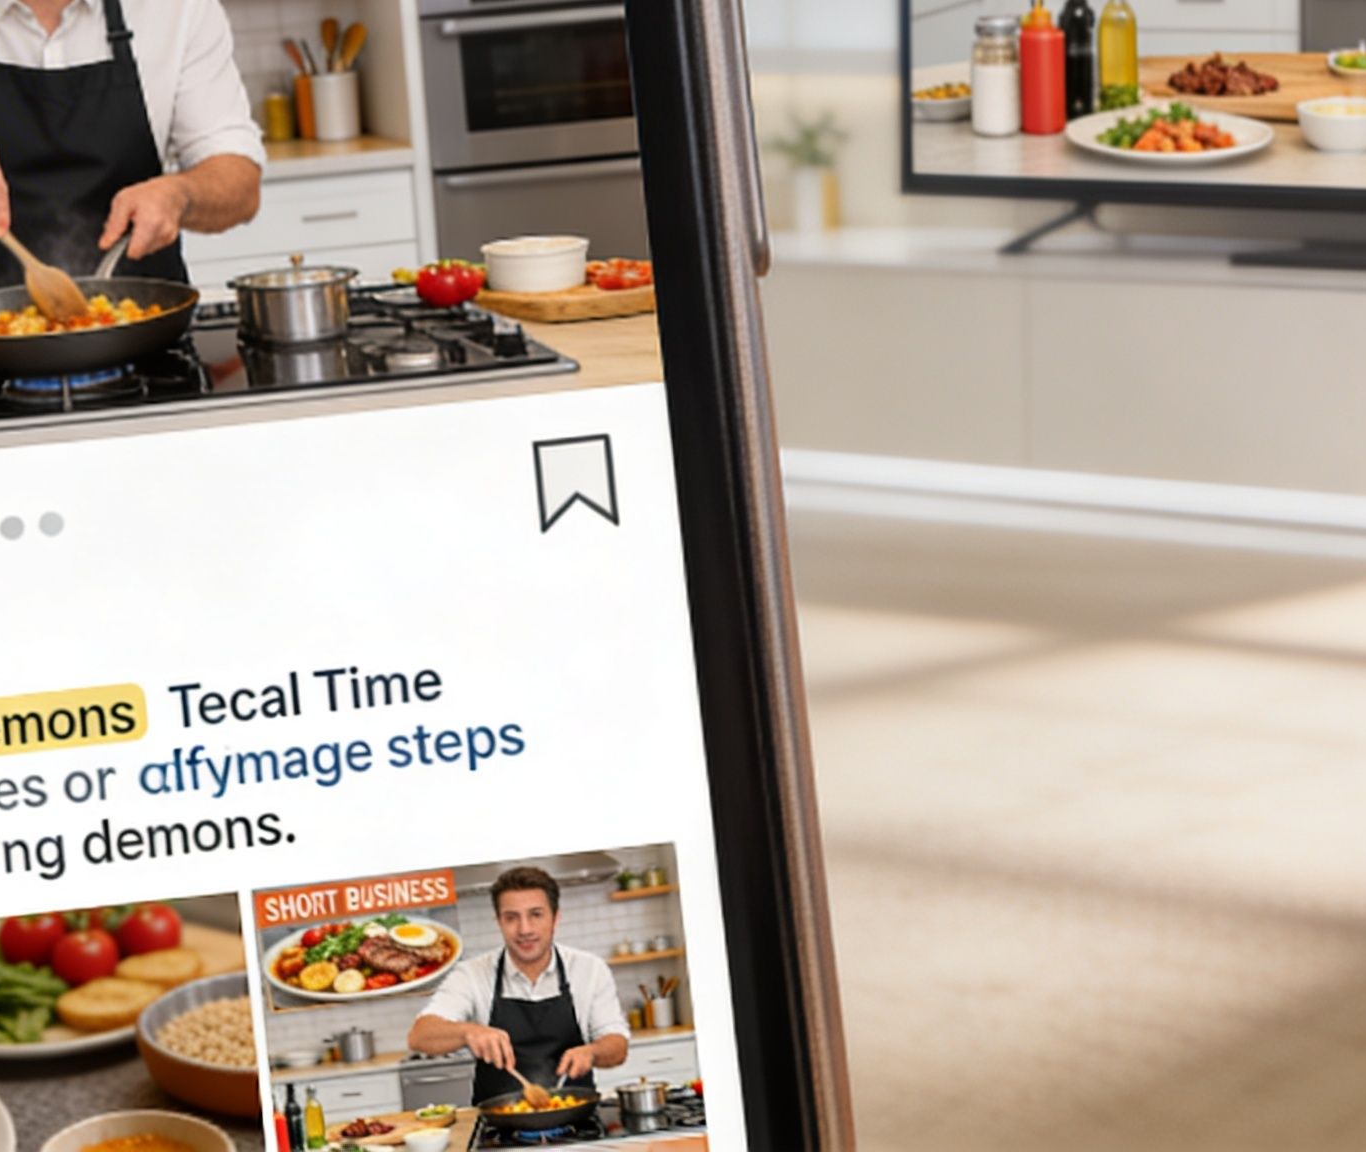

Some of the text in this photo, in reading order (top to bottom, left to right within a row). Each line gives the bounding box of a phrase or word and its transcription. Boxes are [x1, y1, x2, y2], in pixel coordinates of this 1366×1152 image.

[169, 672, 301, 728] Tecal
[313, 667, 442, 713] Time
[64, 764, 116, 804] or
[388, 723, 526, 772] steps
[83, 811, 296, 865] demons.
[264, 876, 449, 923] SHORT BUSINESS
